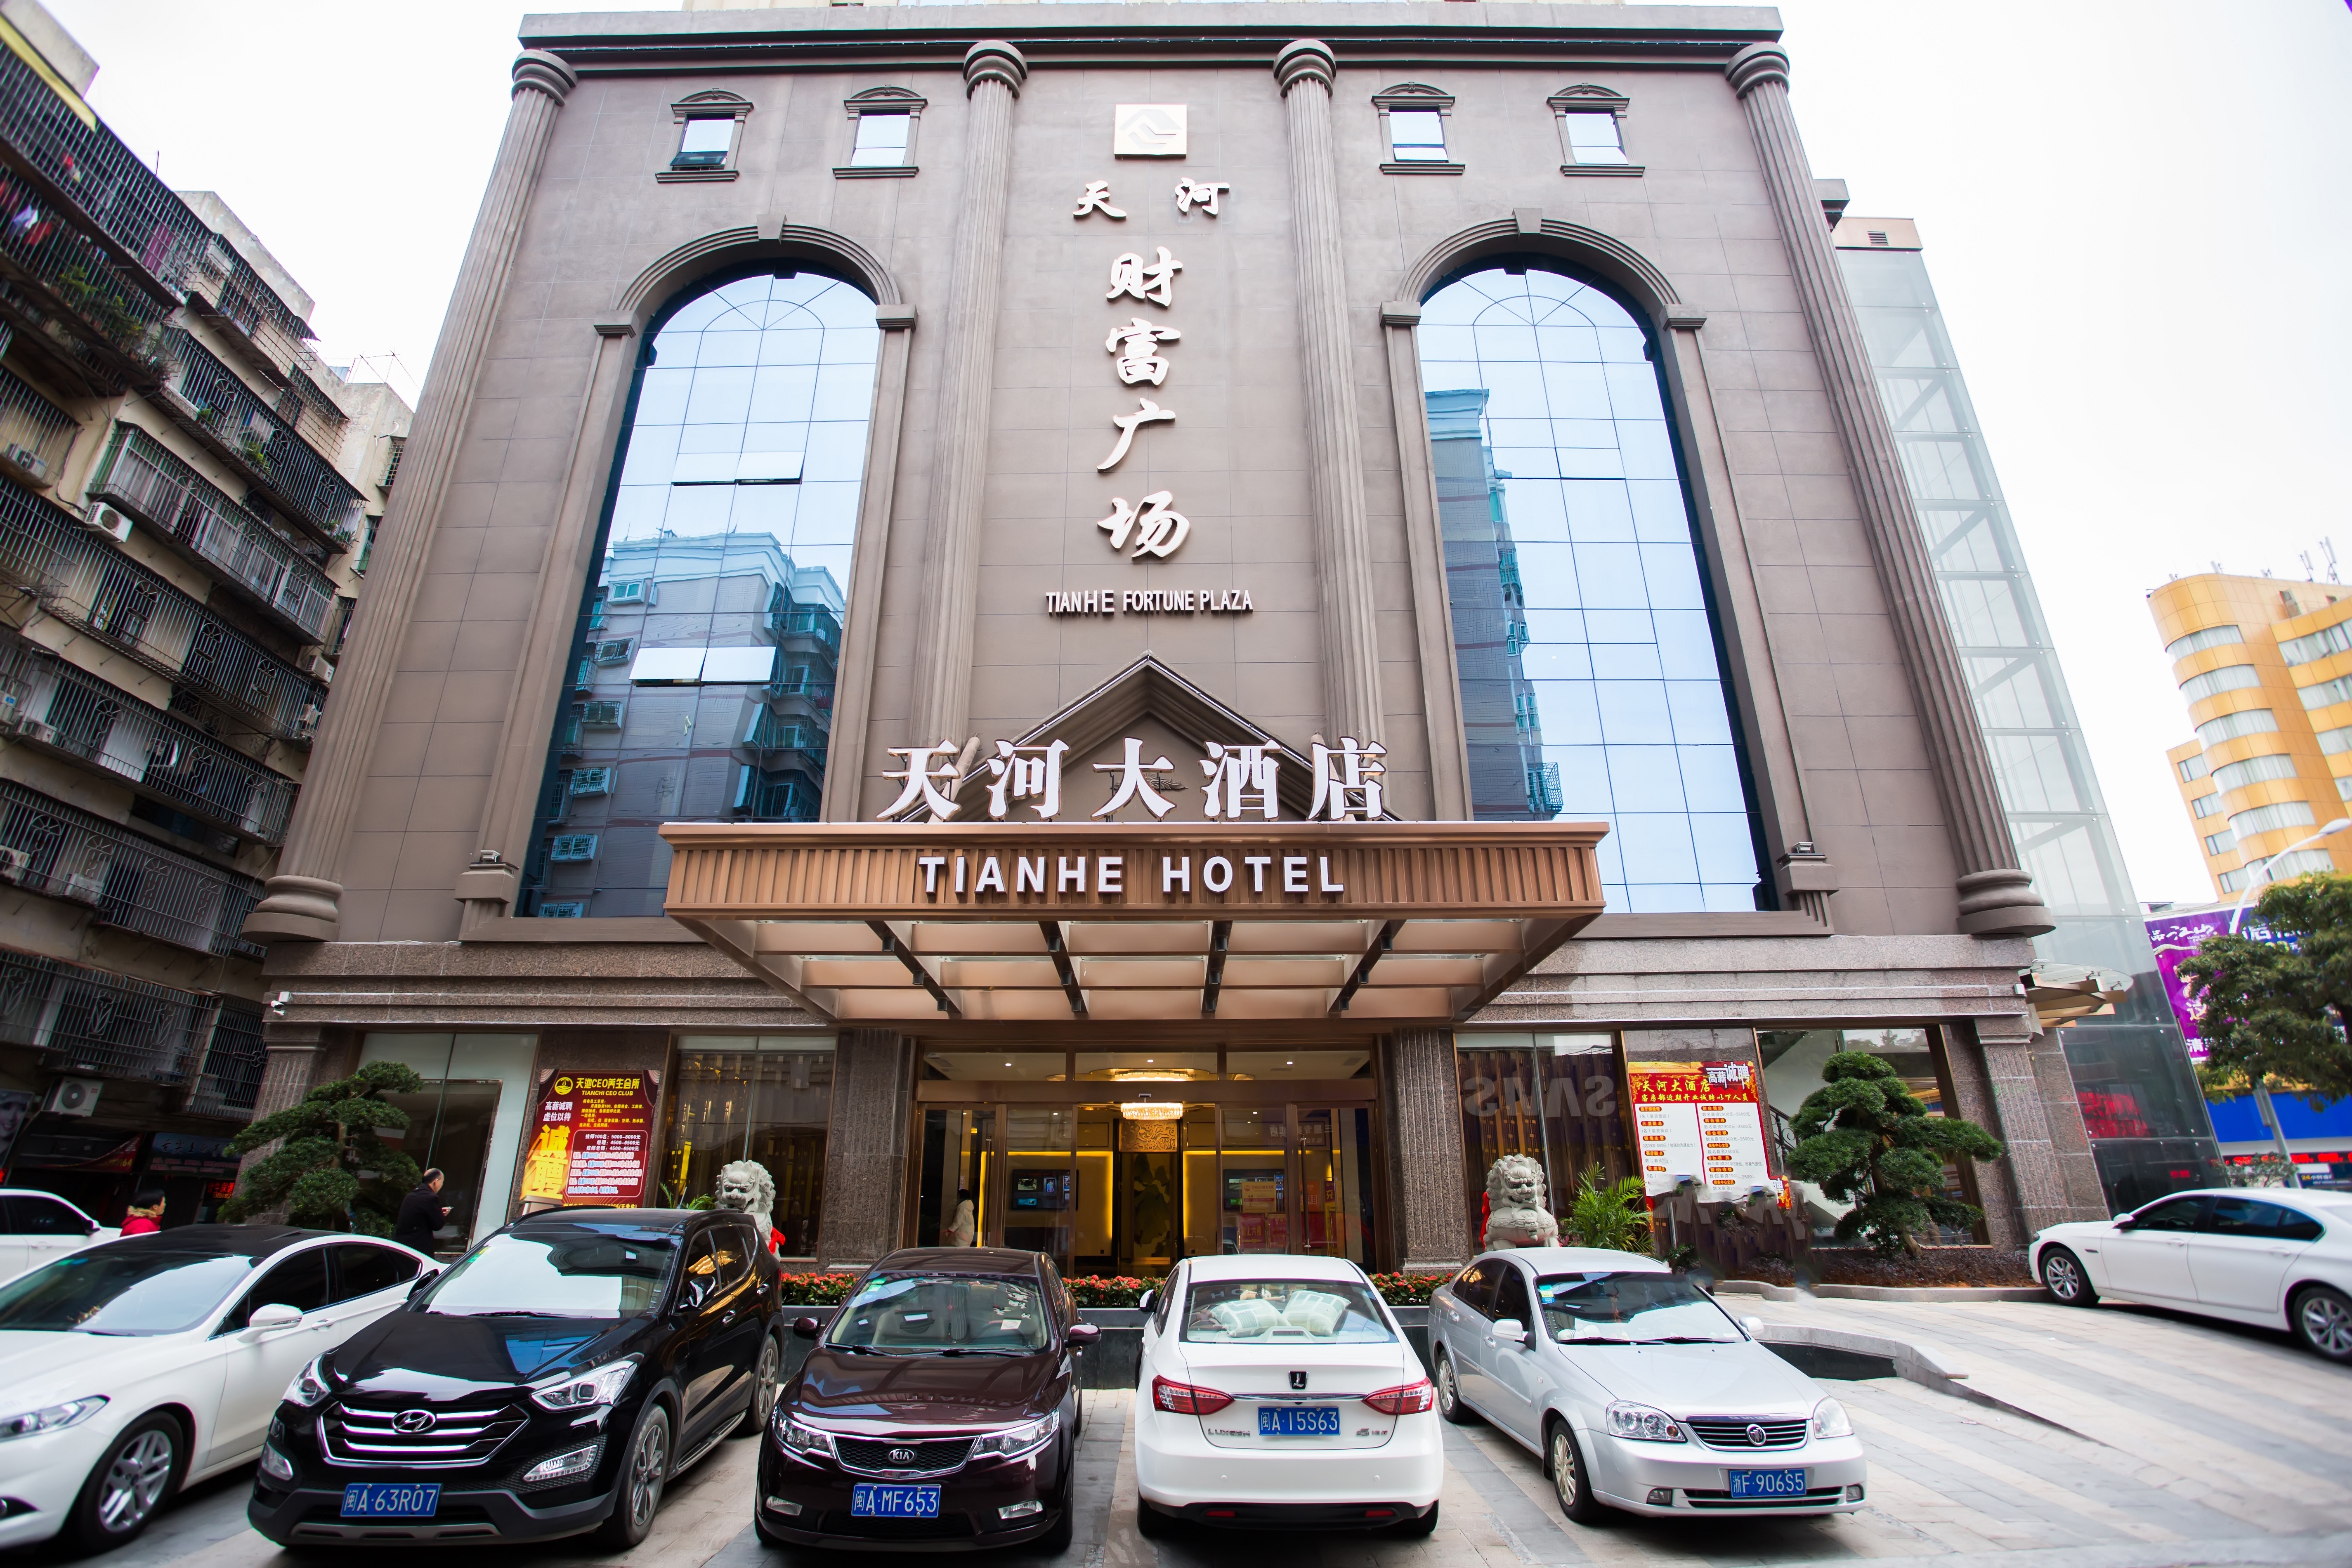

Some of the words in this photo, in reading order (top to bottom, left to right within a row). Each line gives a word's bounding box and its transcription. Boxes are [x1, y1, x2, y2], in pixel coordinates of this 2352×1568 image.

[1073, 177, 1230, 219] 天河
[1097, 246, 1191, 559] 财富广场
[1046, 590, 1115, 615] TIANHE
[1123, 590, 1195, 614] FORTUNE
[1200, 590, 1253, 613] PLAZA
[875, 736, 1388, 822] 天河大酒店
[919, 856, 1124, 895] TIANHE
[1162, 856, 1345, 894] HOTEL
[1641, 1079, 1711, 1093] 天河大酒店
[1705, 1061, 1750, 1090] 高薪诚聘
[545, 1101, 573, 1111] 高薪诚聘
[1641, 1093, 1749, 1102] 客房部近期开业诚聘以下人员
[543, 1112, 571, 1122] 虚位以待
[527, 1124, 571, 1200] 诚聘
[1208, 1428, 1251, 1437] LUXGEN
[893, 1450, 909, 1460] KIA
